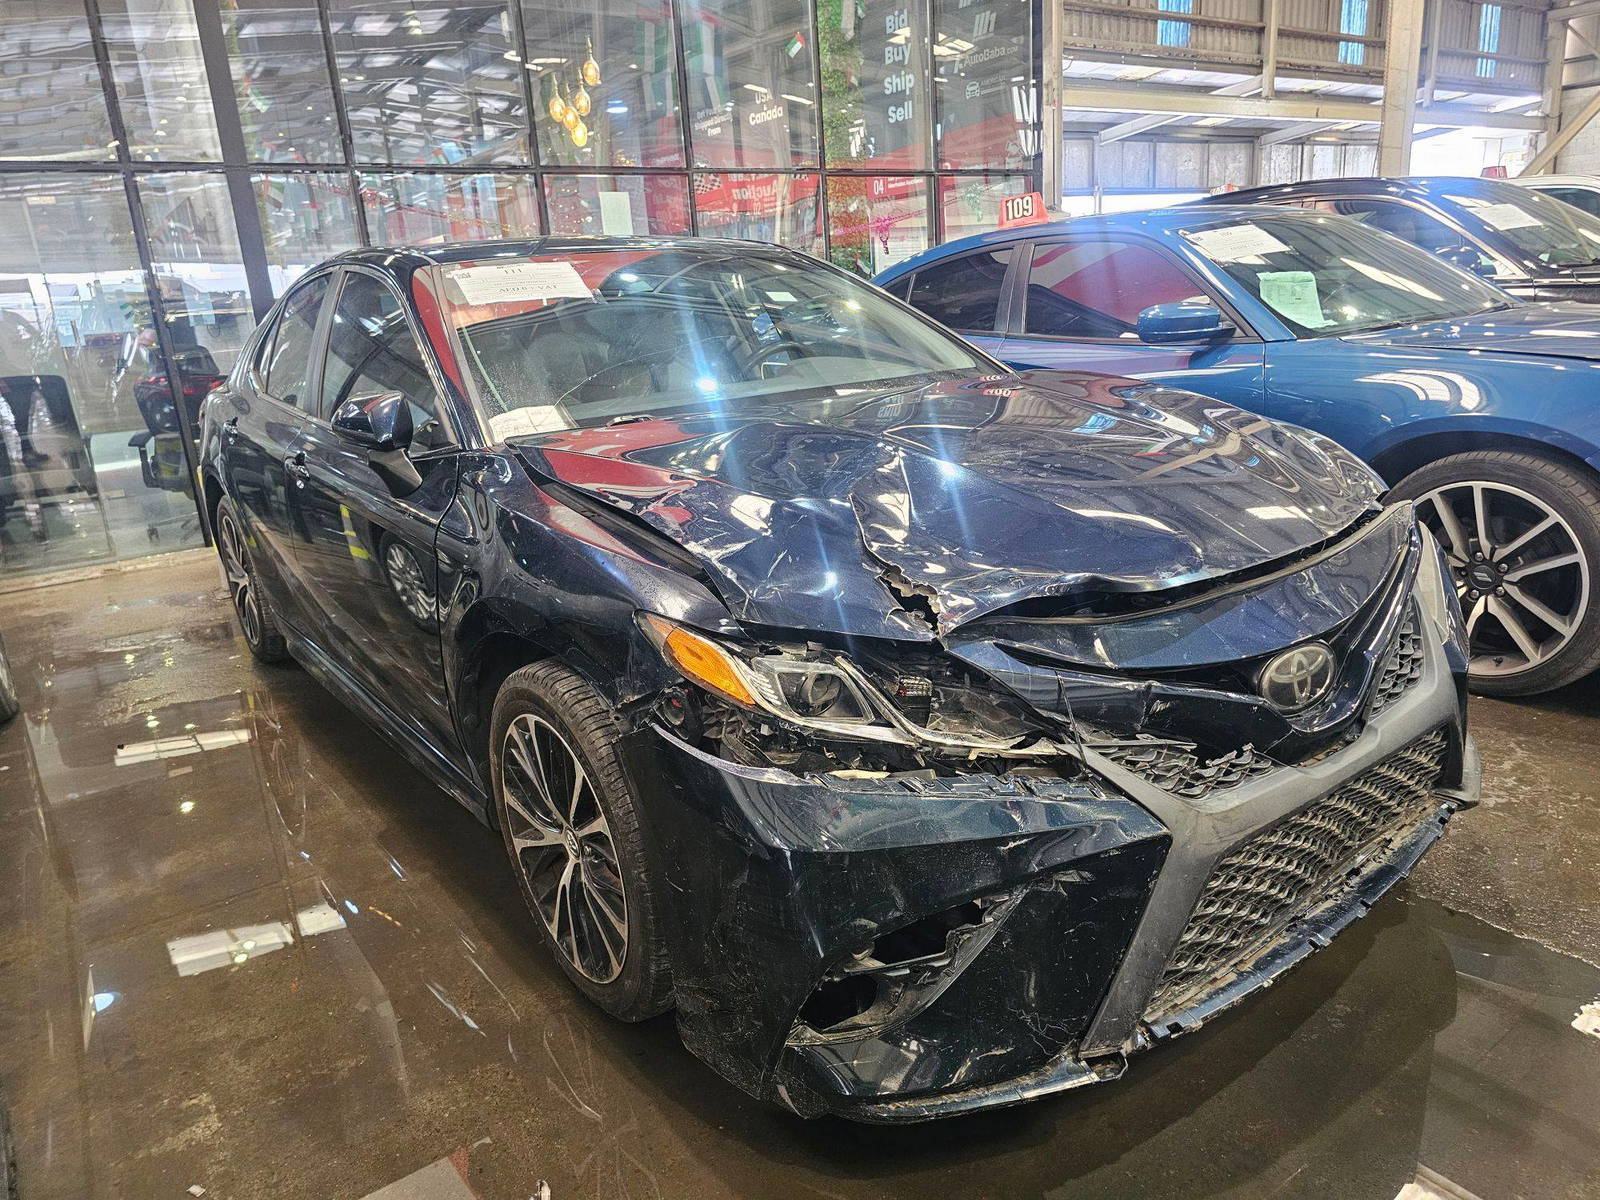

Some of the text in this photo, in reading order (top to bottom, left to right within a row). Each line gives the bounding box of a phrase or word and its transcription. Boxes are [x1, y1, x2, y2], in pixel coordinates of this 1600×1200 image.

[885, 8, 908, 34] Bid
[884, 42, 911, 65] Buy
[754, 88, 773, 104] USA
[748, 105, 783, 126] Canada
[887, 100, 912, 123] Sell
[874, 179, 884, 195] 04
[1006, 195, 1034, 221] 109
